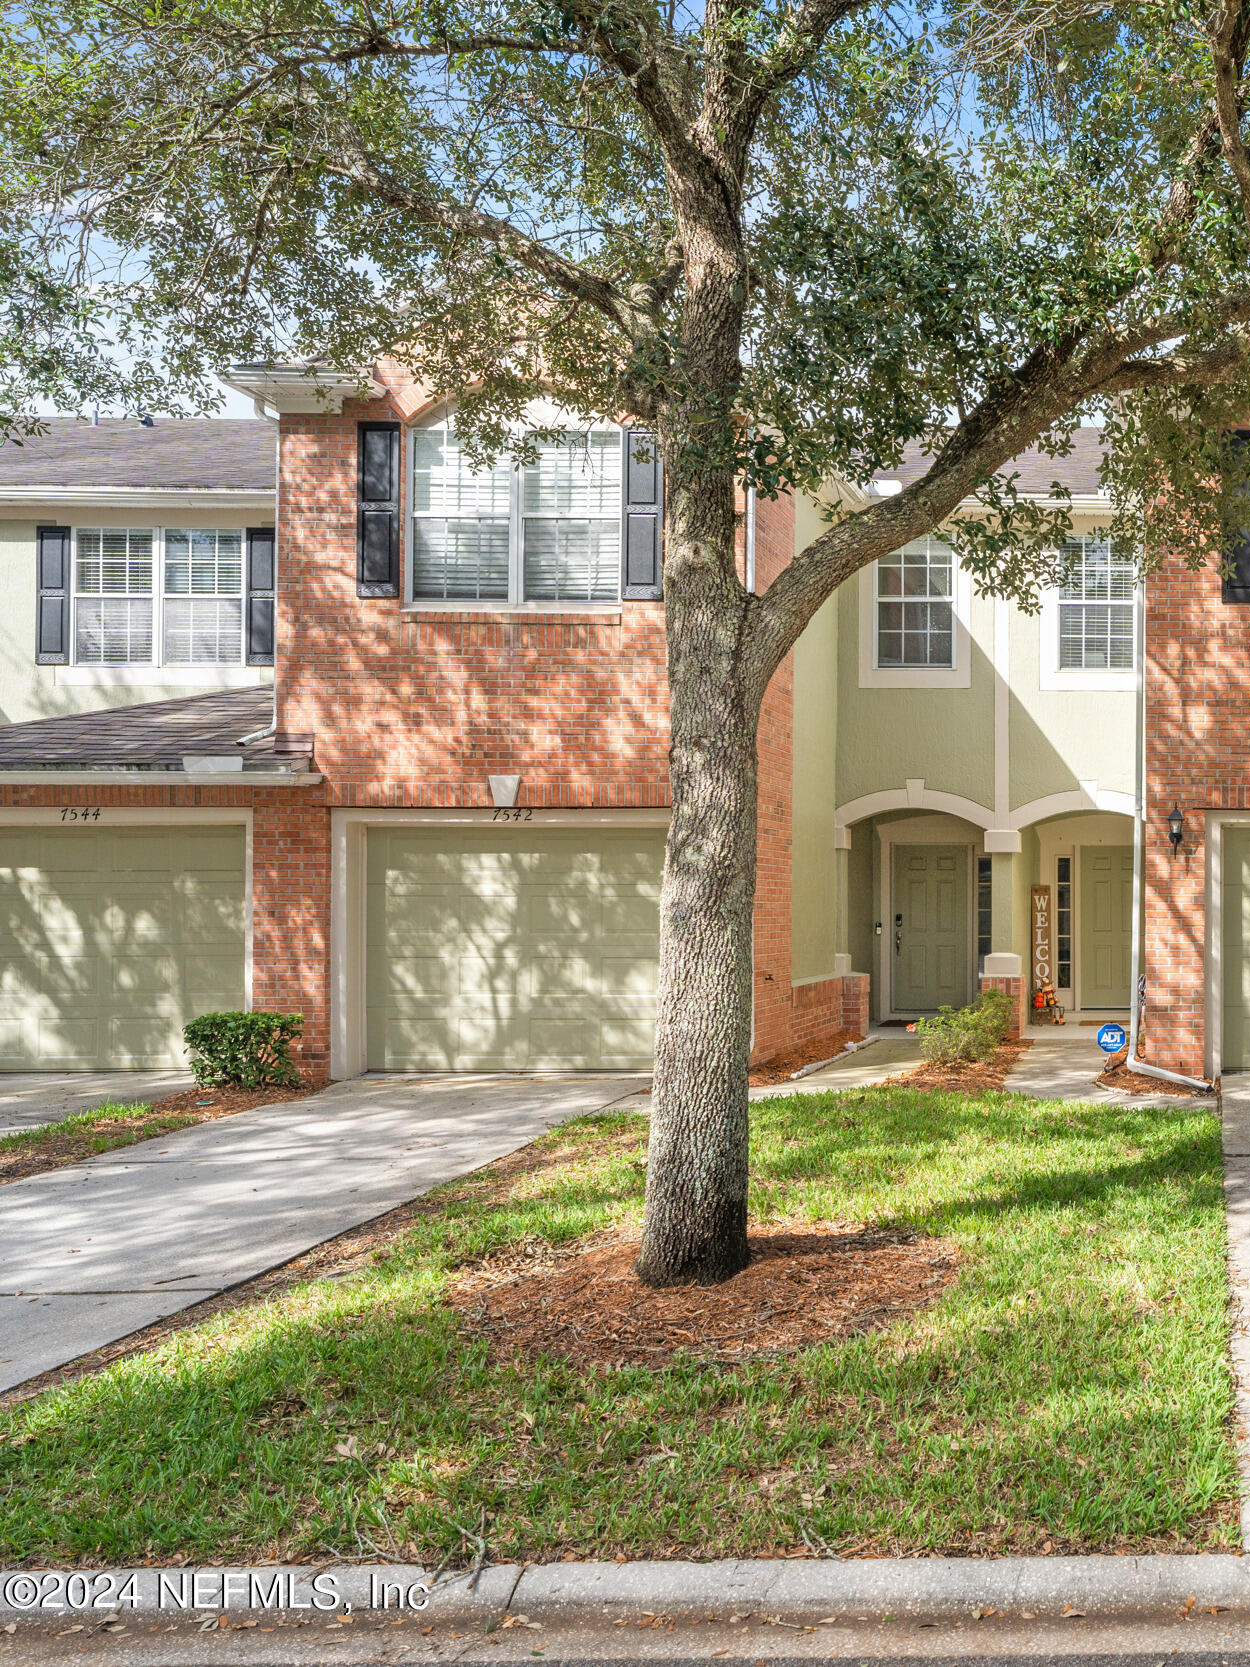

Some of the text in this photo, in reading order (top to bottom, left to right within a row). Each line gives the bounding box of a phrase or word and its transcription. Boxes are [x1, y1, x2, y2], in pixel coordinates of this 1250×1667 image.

[61, 808, 100, 821] 7544
[493, 809, 533, 821] 7542
[1100, 1031, 1124, 1043] ADT
